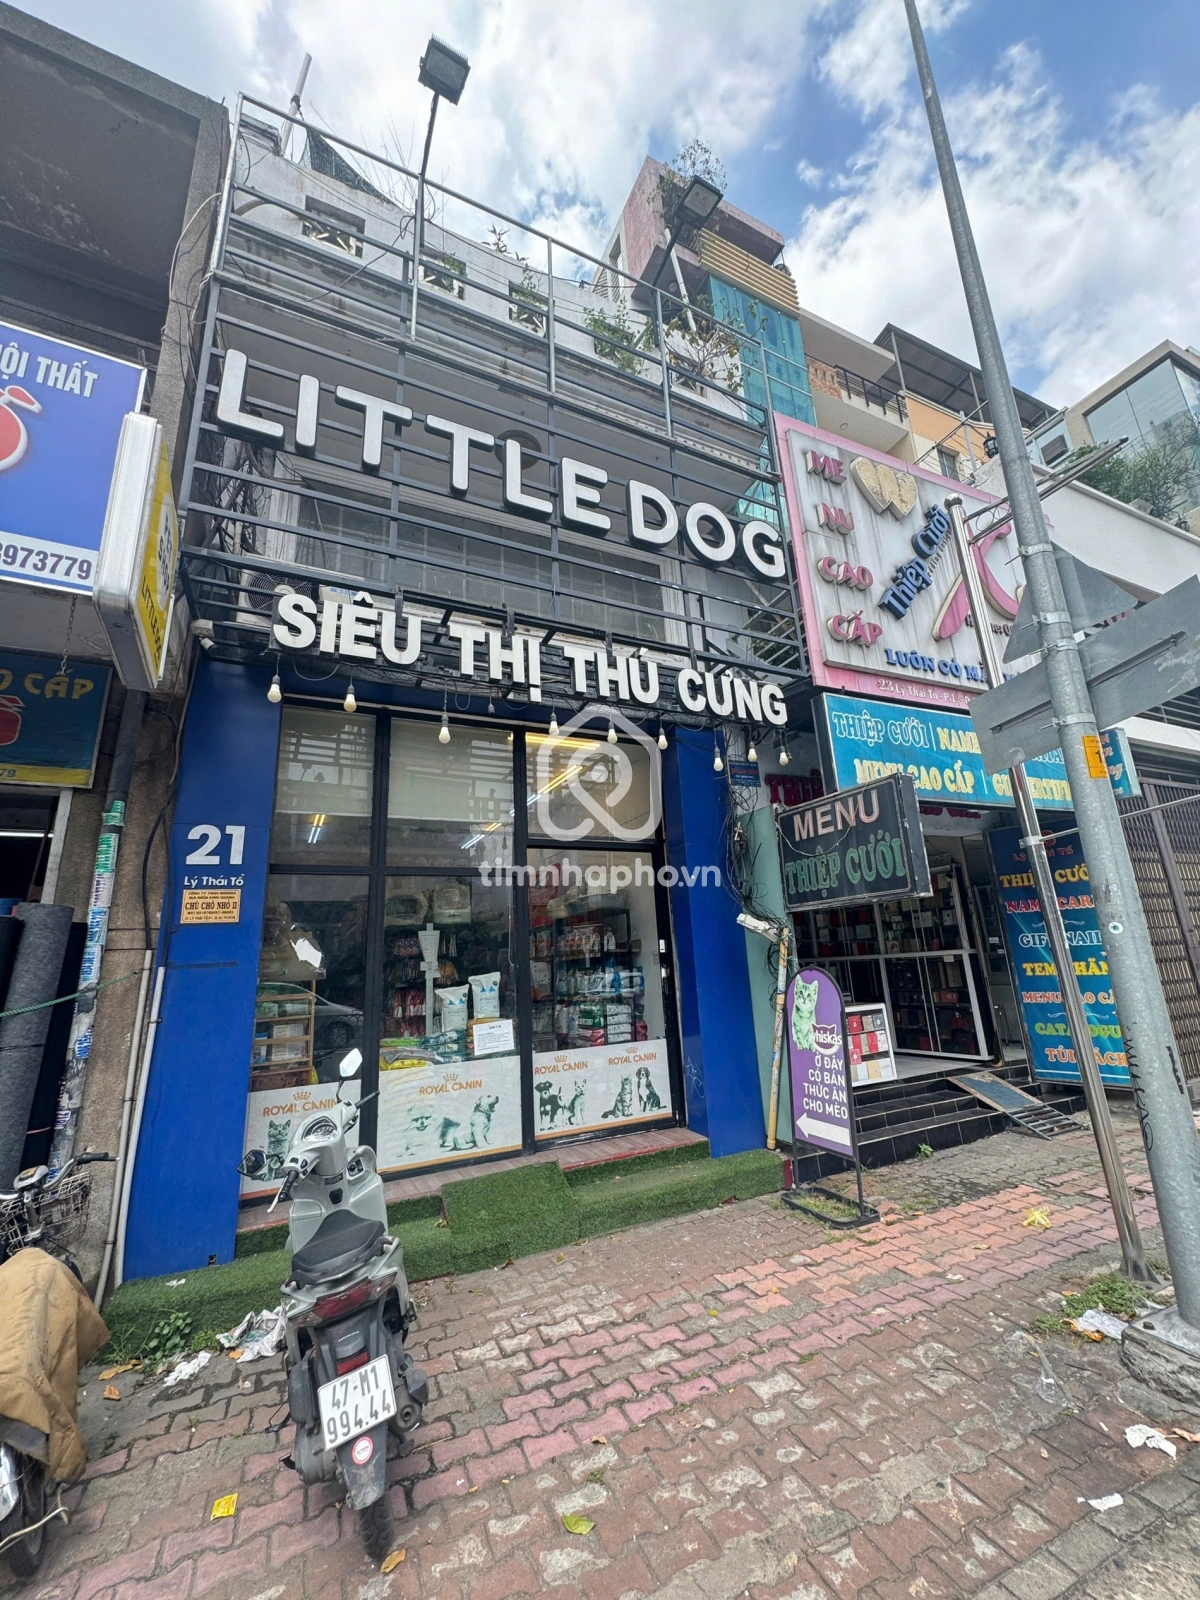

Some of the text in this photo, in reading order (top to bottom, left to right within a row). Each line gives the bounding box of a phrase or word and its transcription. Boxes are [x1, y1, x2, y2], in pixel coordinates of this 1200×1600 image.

[0, 341, 99, 398] ỘI THẤT
[216, 348, 787, 580] LITTLE DOG
[806, 450, 847, 484] ME
[817, 502, 855, 535] NU
[818, 556, 873, 591] CAO
[878, 504, 951, 620] Thiệp Cưới
[827, 610, 883, 647] CẤP
[273, 591, 788, 725] SIÊU THỊ THÚ CƯNG
[885, 648, 935, 672] LUÔN
[938, 658, 962, 678] CÓ
[24, 669, 94, 699] CẤP
[878, 679, 894, 692] 23
[907, 685, 926, 698] Thái
[832, 710, 885, 747] THIỆP
[887, 717, 930, 748] CƯỚI
[944, 759, 974, 794] CẤP
[793, 789, 880, 841] MENU
[185, 824, 246, 865] 21
[785, 829, 906, 898] THIỆP CƯỚI
[183, 873, 245, 889] Lý Thái Tổ
[185, 900, 200, 910] CHÚ
[1005, 894, 1095, 914] NAM CAR
[808, 1030, 843, 1046] whiskas
[534, 1060, 588, 1075] ROYAL CANIN
[608, 1051, 658, 1066] ROYAL CANIN
[824, 1055, 843, 1071] ĐÂY
[419, 1078, 483, 1097] ROYAL CANIN
[803, 1083, 847, 1103] THỨC ĂN
[809, 1068, 845, 1087] CÓ BÁN
[263, 1103, 299, 1118] ROYAL
[803, 1098, 848, 1119] CHO MÈO
[332, 1365, 380, 1409] 47-M1
[327, 1389, 391, 1444] 994.44
